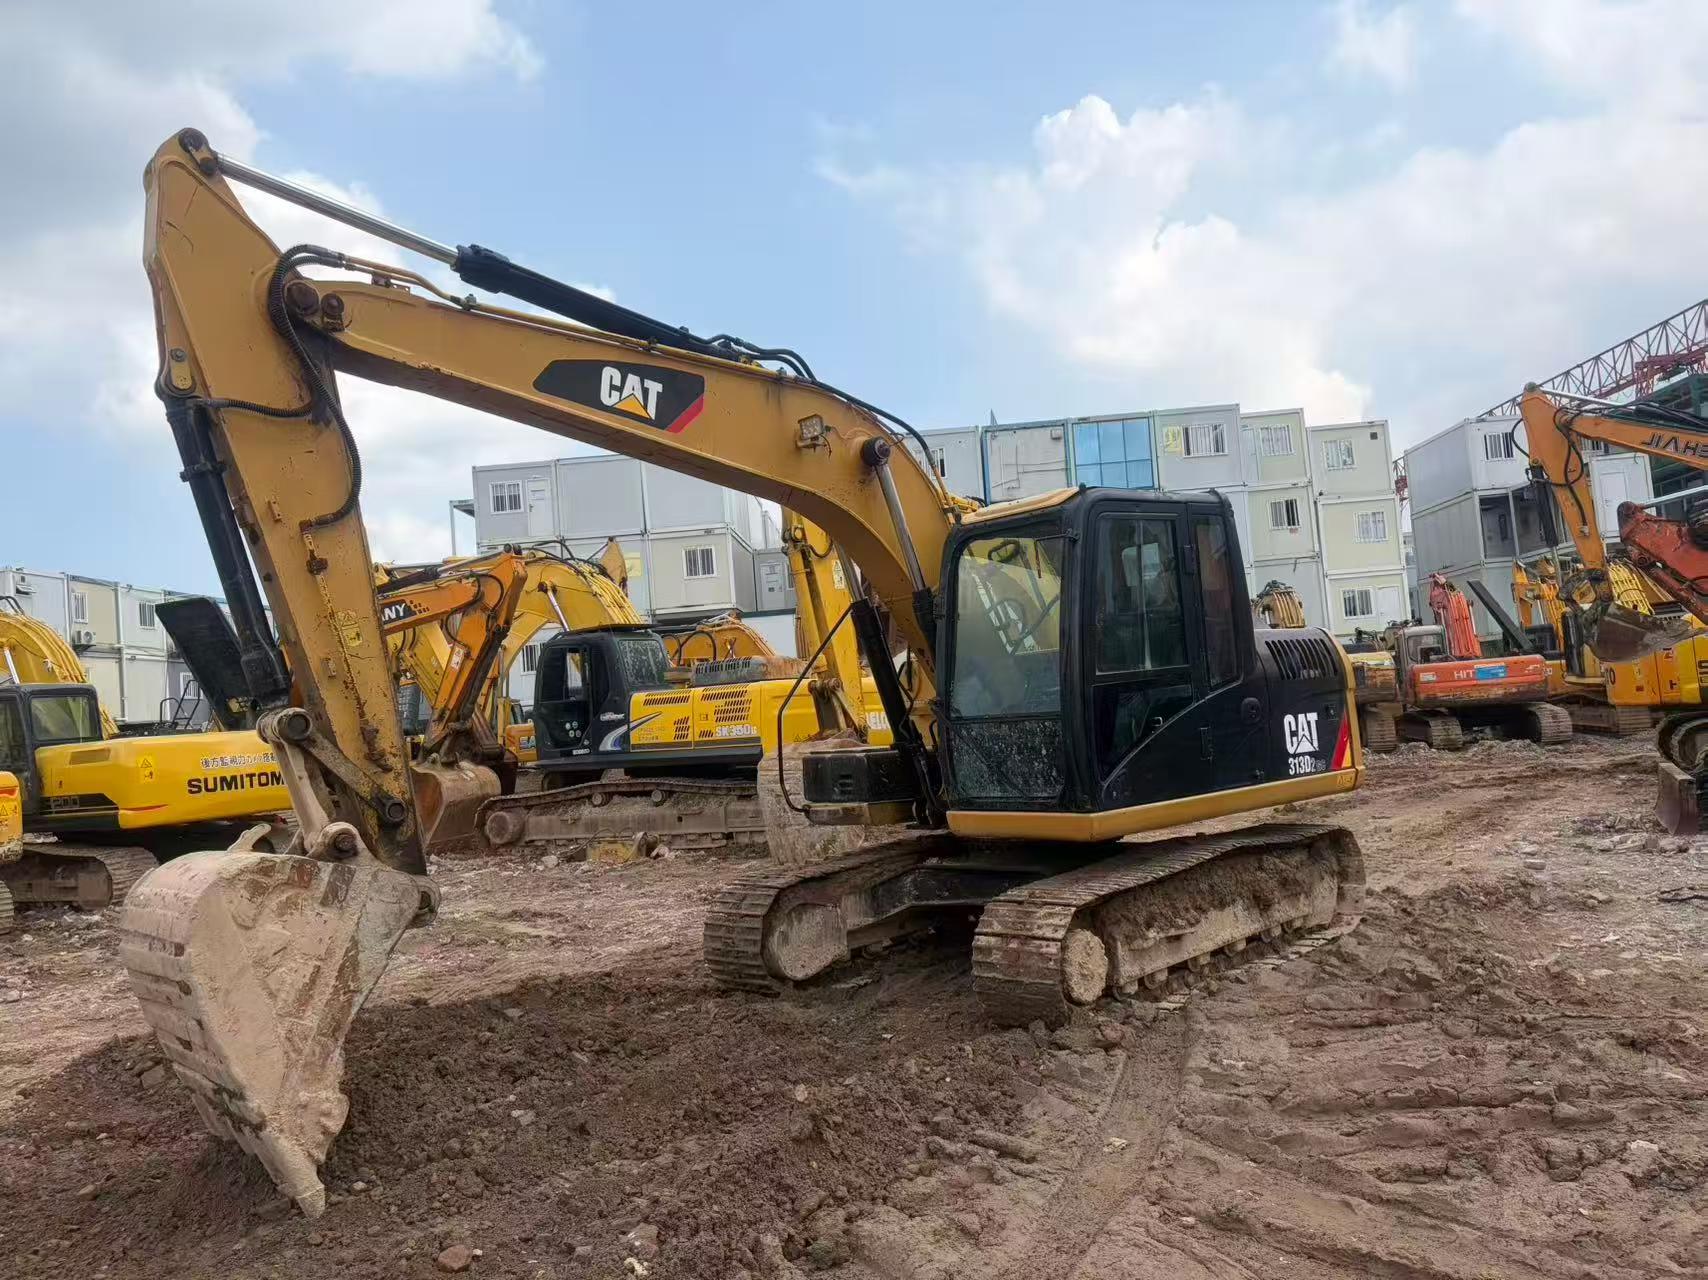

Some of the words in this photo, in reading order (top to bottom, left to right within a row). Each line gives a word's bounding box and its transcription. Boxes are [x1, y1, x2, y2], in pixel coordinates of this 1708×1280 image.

[600, 366, 663, 420] CAT
[1454, 669, 1475, 681] HIT
[519, 736, 536, 749] SA
[1284, 712, 1319, 754] CAT
[187, 771, 285, 794] SUMITOM
